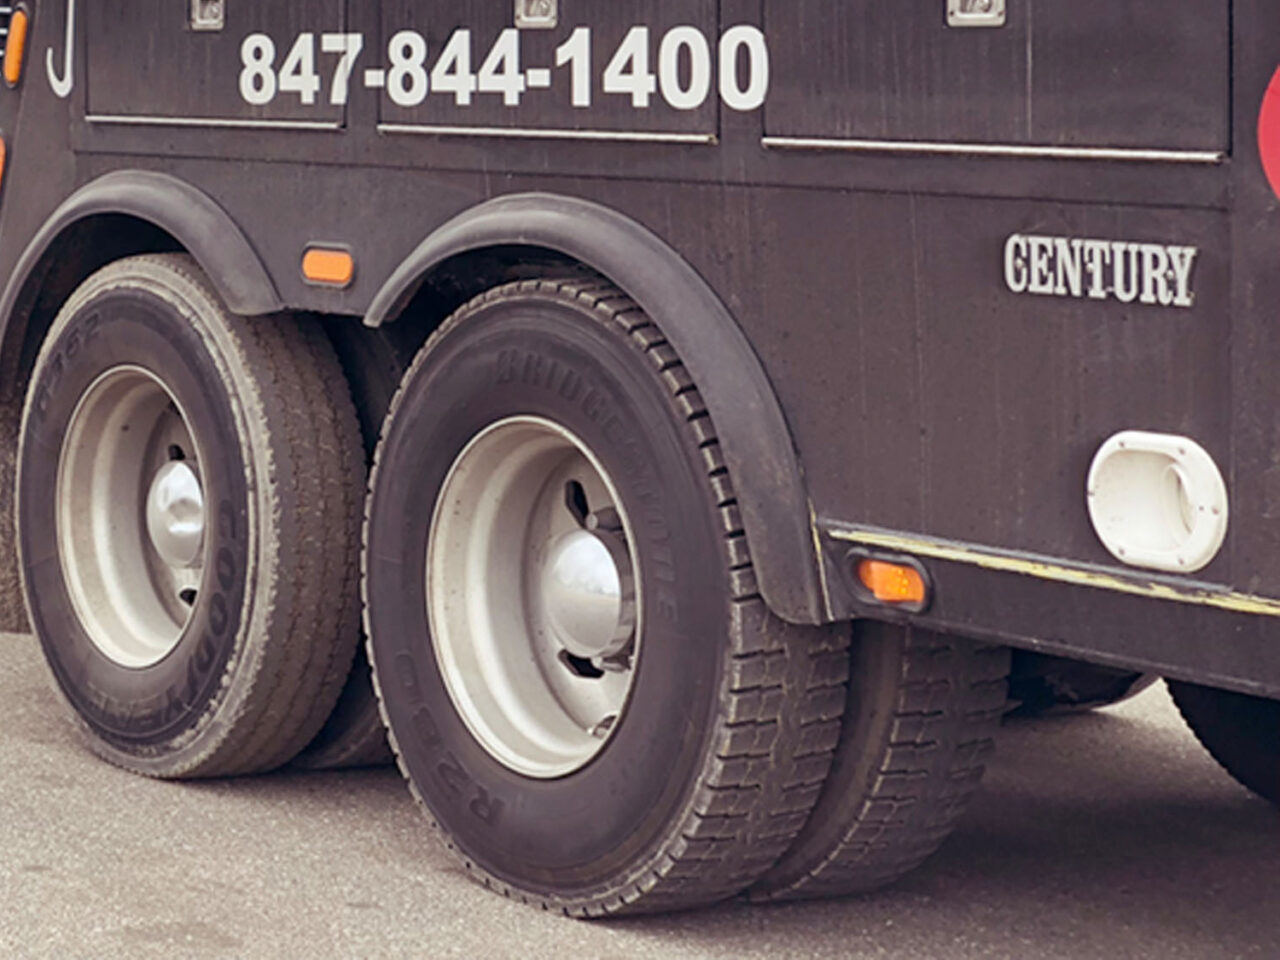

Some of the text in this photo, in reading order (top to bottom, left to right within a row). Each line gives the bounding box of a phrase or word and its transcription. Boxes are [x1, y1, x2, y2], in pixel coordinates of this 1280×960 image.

[239, 25, 770, 111] 847-844-1400
[1004, 233, 1197, 307] CENTURY
[496, 349, 679, 625] BRIDGESTONE
